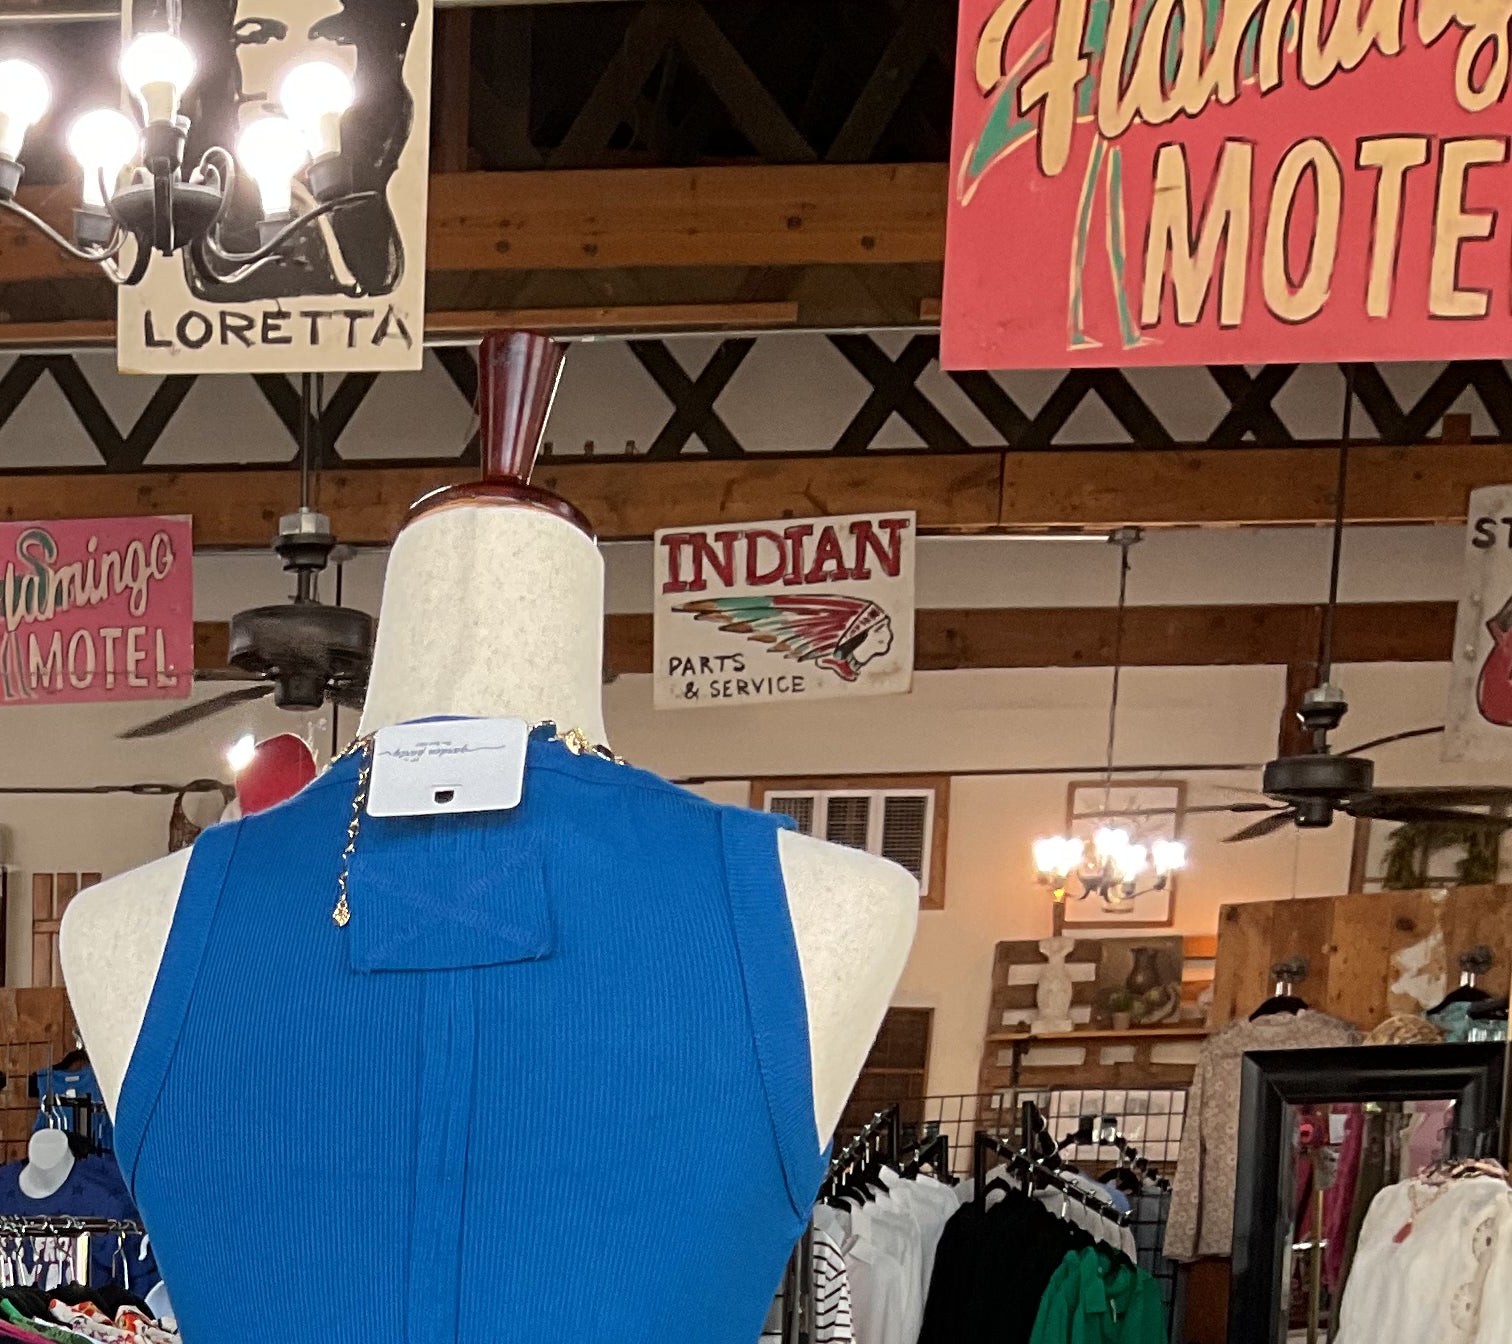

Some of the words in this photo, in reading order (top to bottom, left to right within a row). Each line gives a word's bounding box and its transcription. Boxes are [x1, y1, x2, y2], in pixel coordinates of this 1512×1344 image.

[1141, 133, 1512, 329] MOTE
[144, 303, 414, 350] LORETTA
[660, 519, 911, 594] INDIAN
[28, 625, 179, 691] MOTEL
[668, 653, 746, 677] PARTS
[684, 682, 700, 699] &
[711, 675, 806, 698] SERVICE
